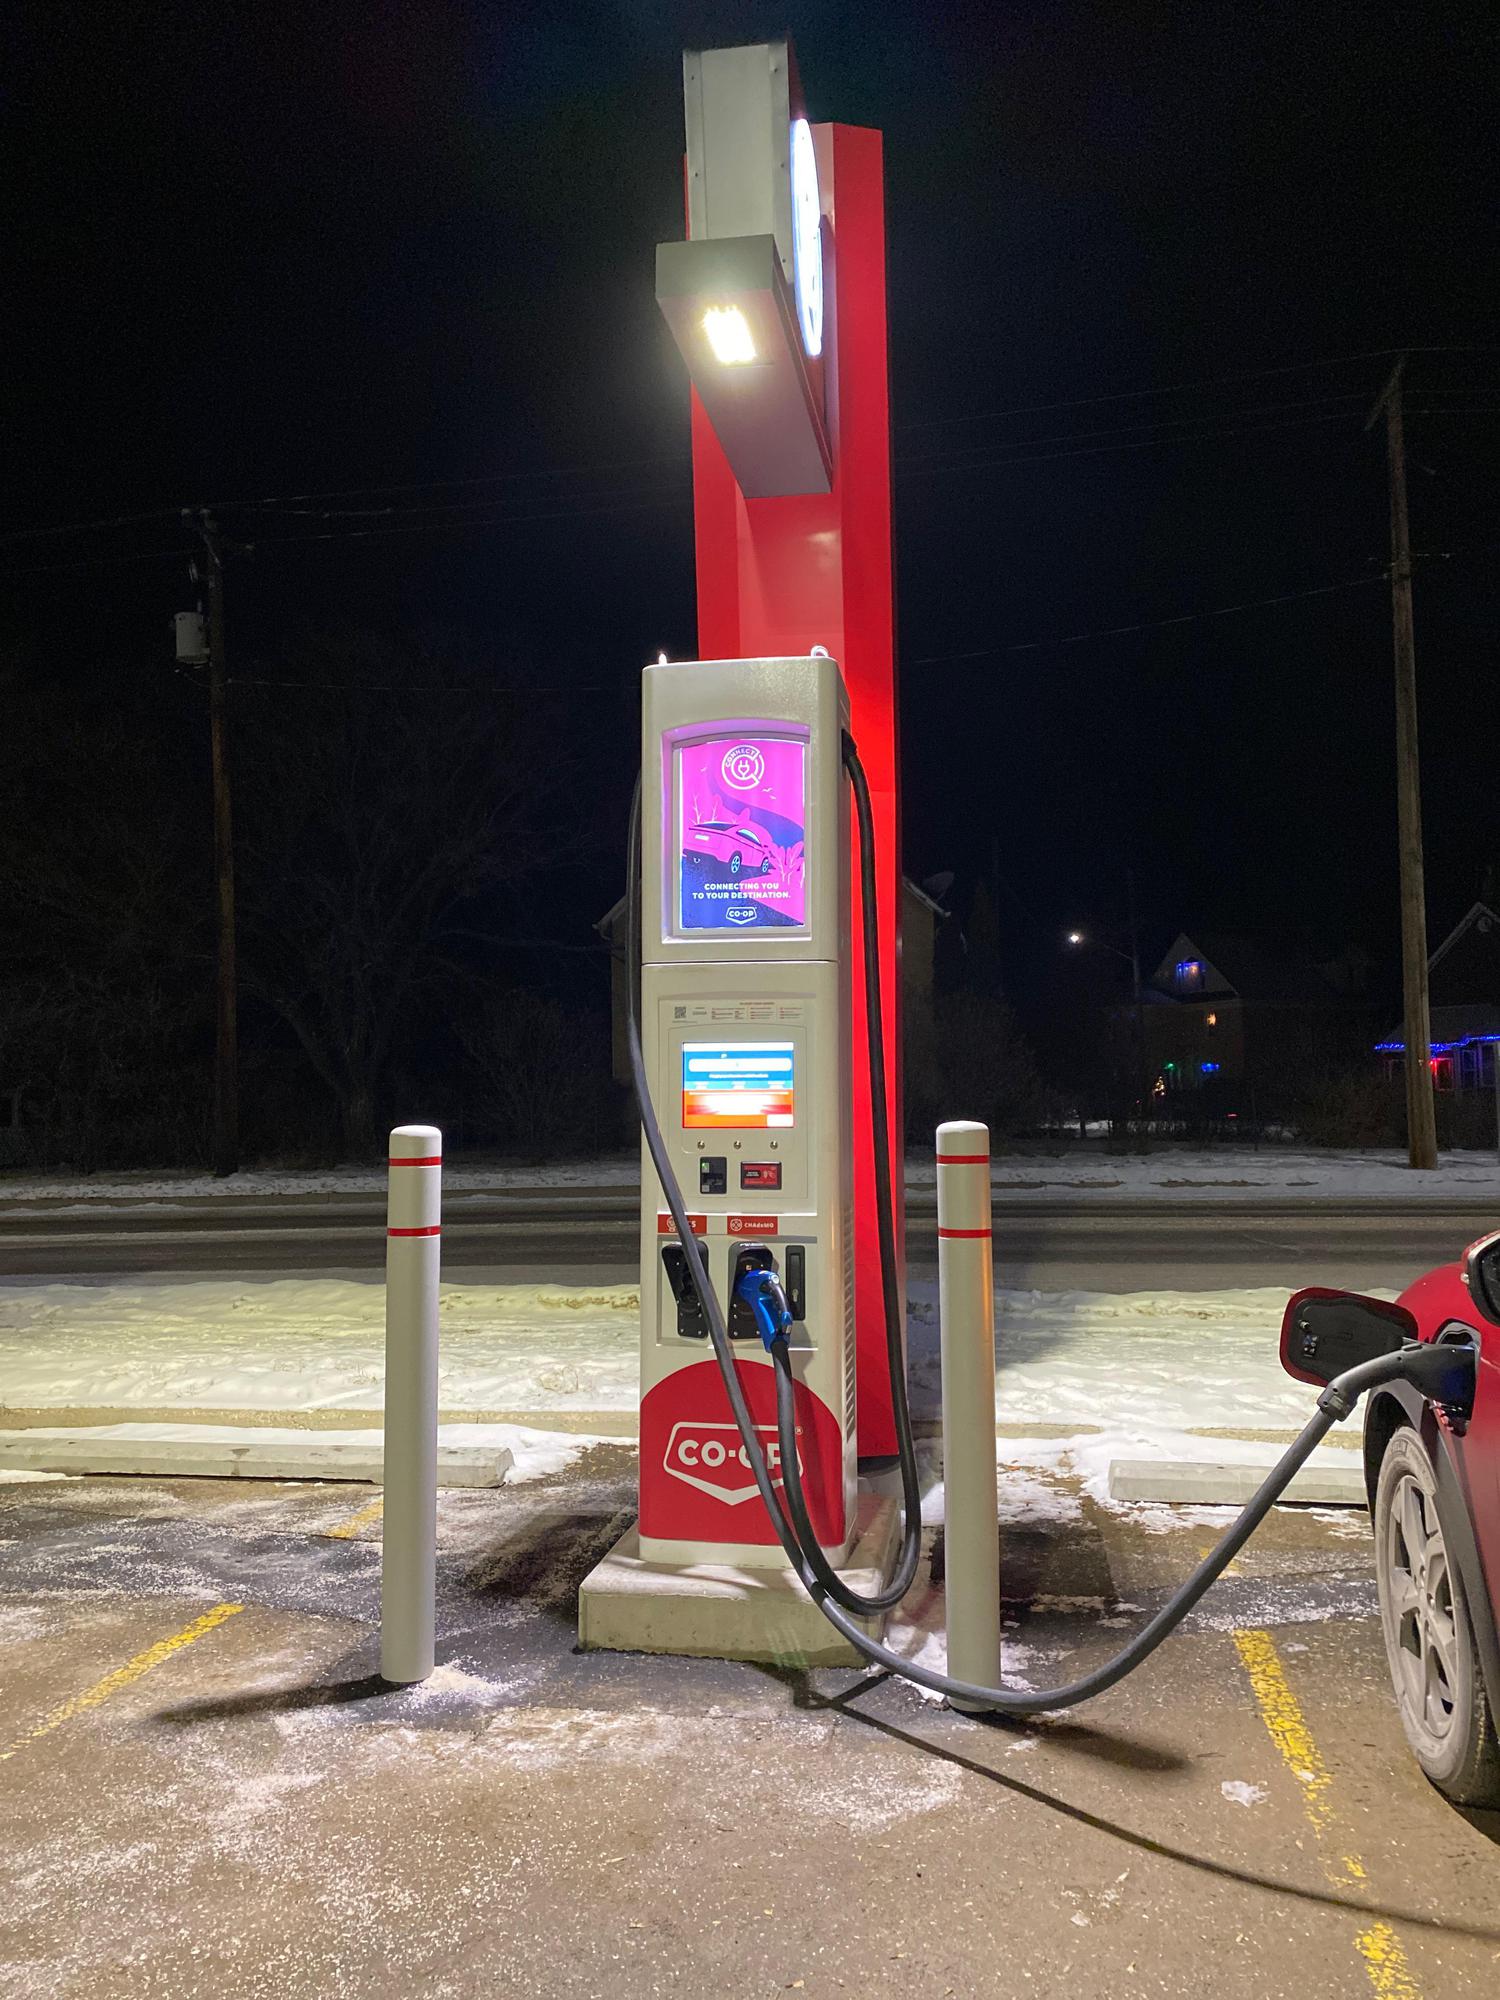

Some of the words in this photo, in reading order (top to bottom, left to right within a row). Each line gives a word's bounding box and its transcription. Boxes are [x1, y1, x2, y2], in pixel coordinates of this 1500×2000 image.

[726, 748, 756, 768] CONNECT
[704, 883, 760, 891] CONNECTING
[761, 882, 780, 890] YOU
[692, 892, 705, 900] TO
[706, 891, 730, 899] YOUR
[731, 891, 791, 899] DESTINATION.
[728, 910, 754, 918] CO-OP
